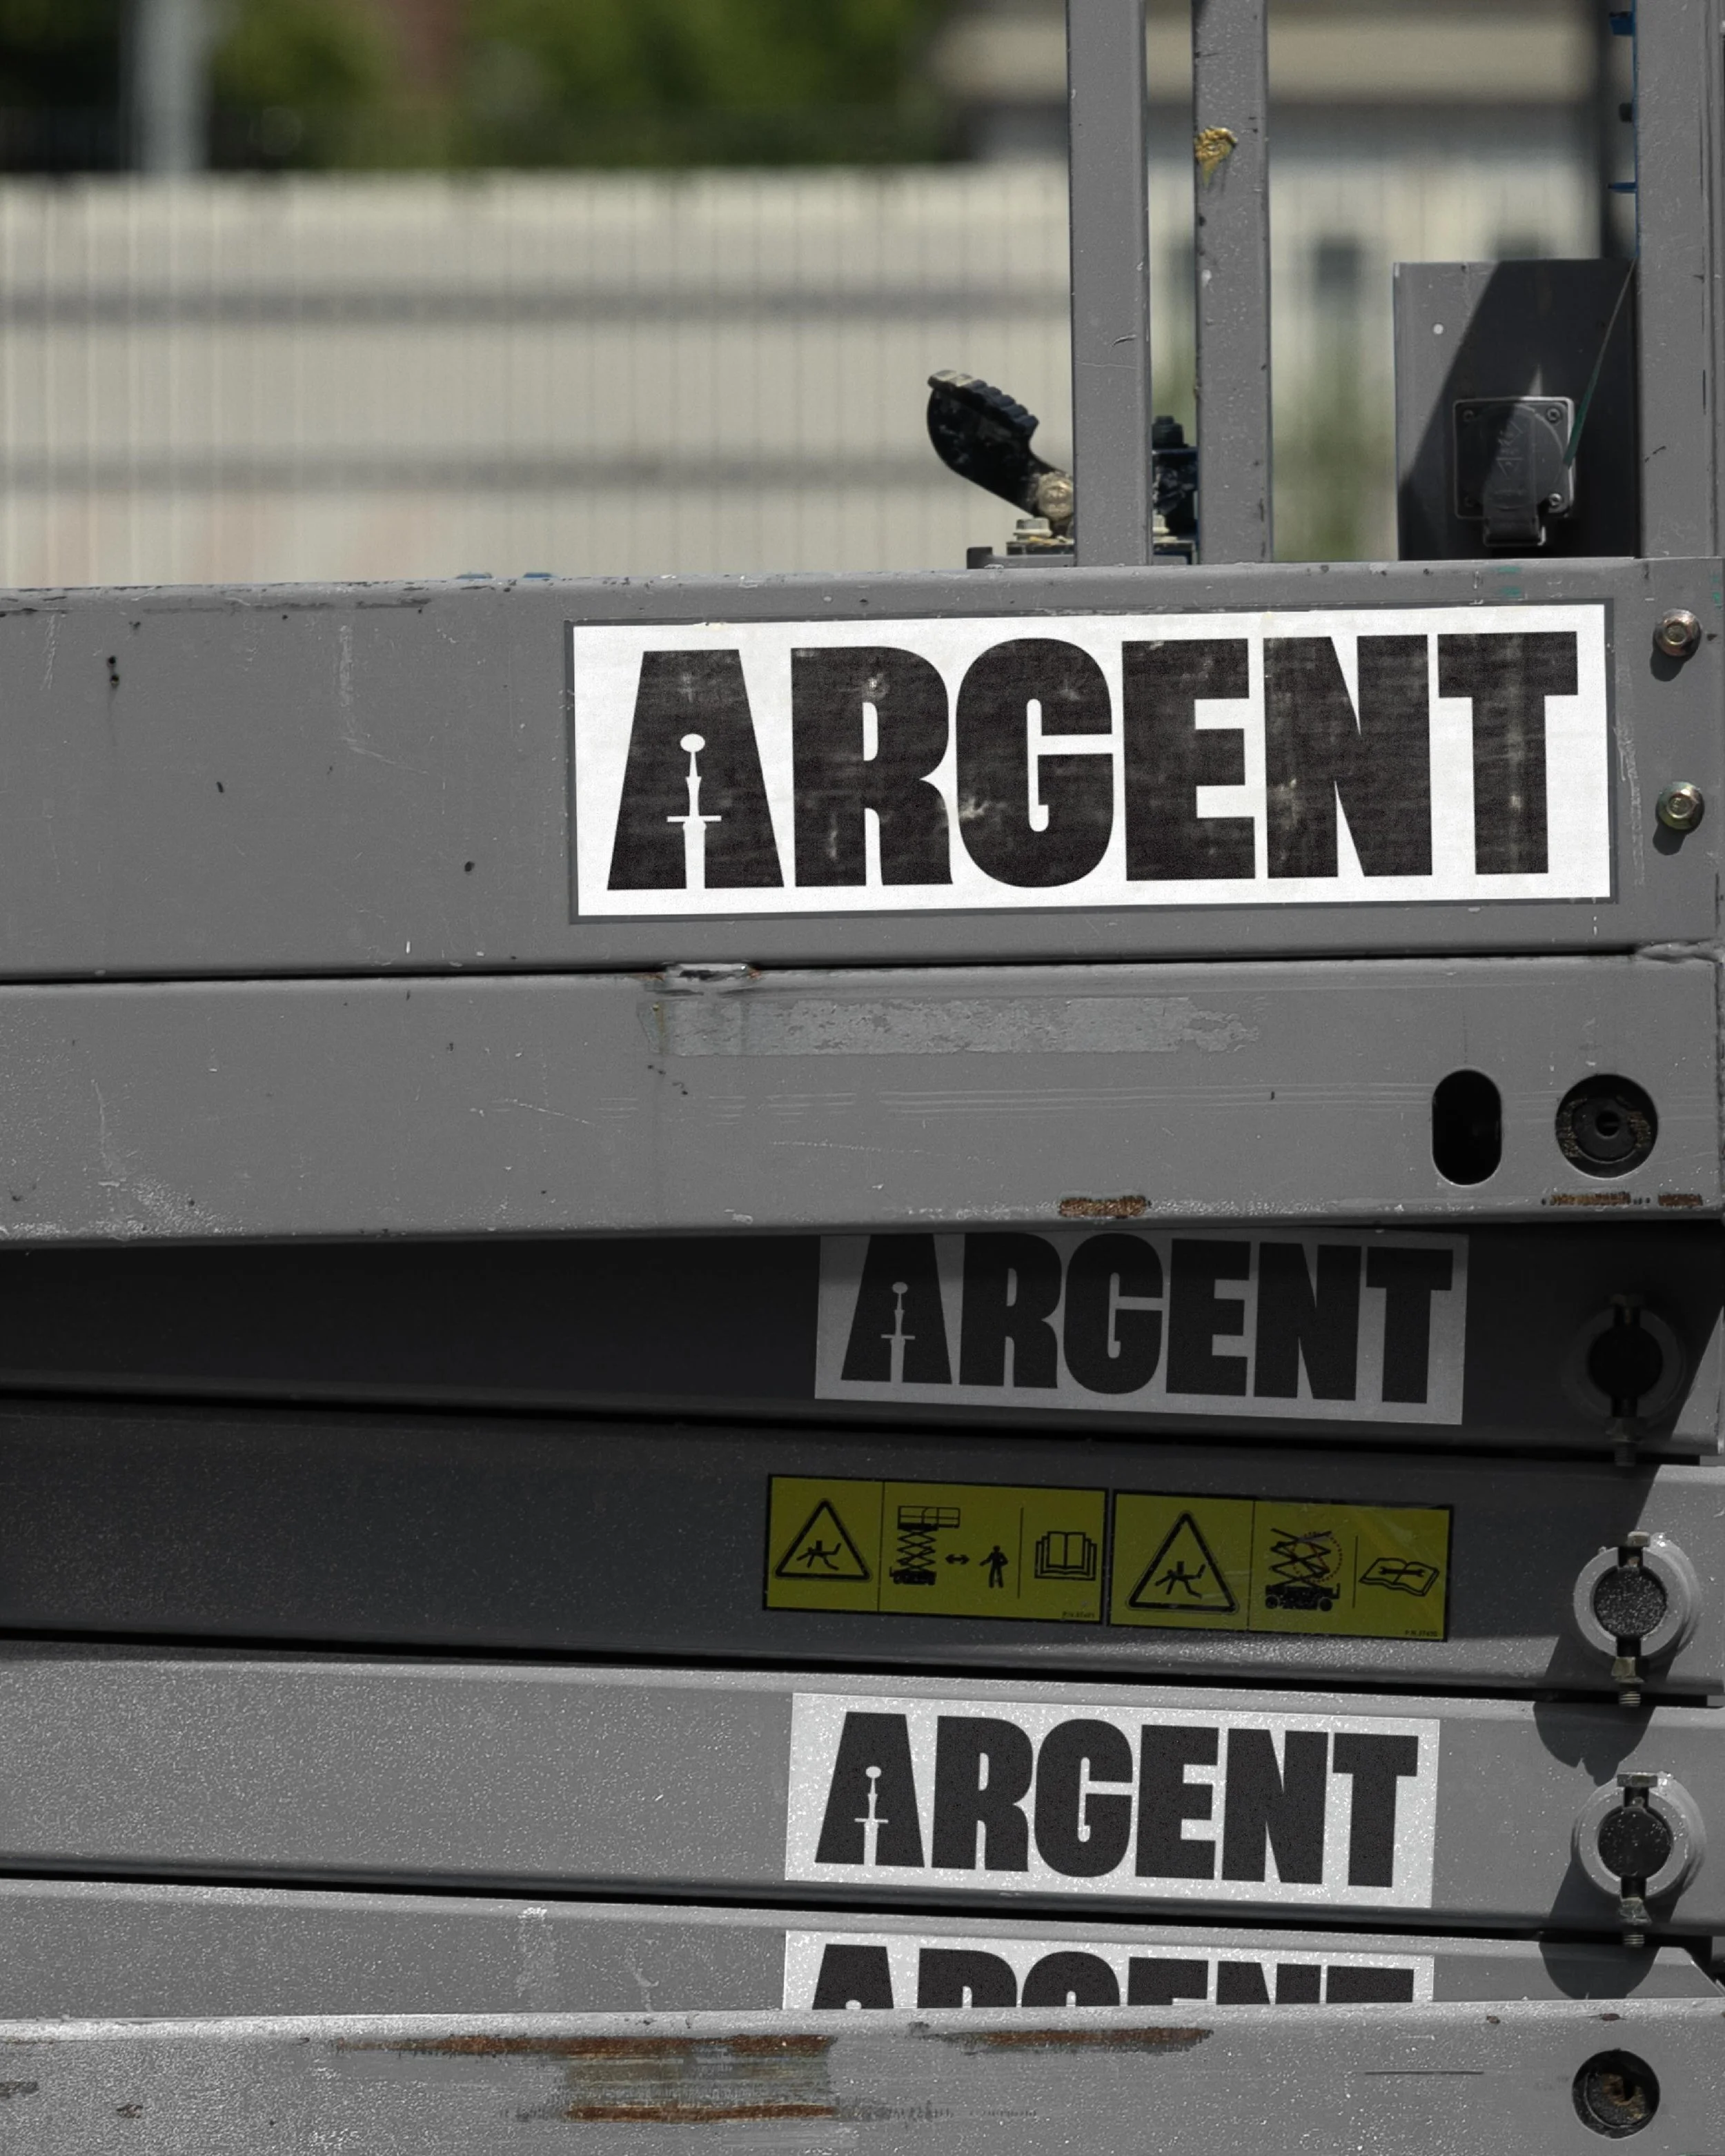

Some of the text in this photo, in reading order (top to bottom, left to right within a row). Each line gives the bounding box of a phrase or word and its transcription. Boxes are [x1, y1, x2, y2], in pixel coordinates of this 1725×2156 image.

[607, 631, 1578, 891] ARGENT
[840, 1233, 1454, 1405] ARGENT
[815, 1711, 1419, 1888] ARGENT
